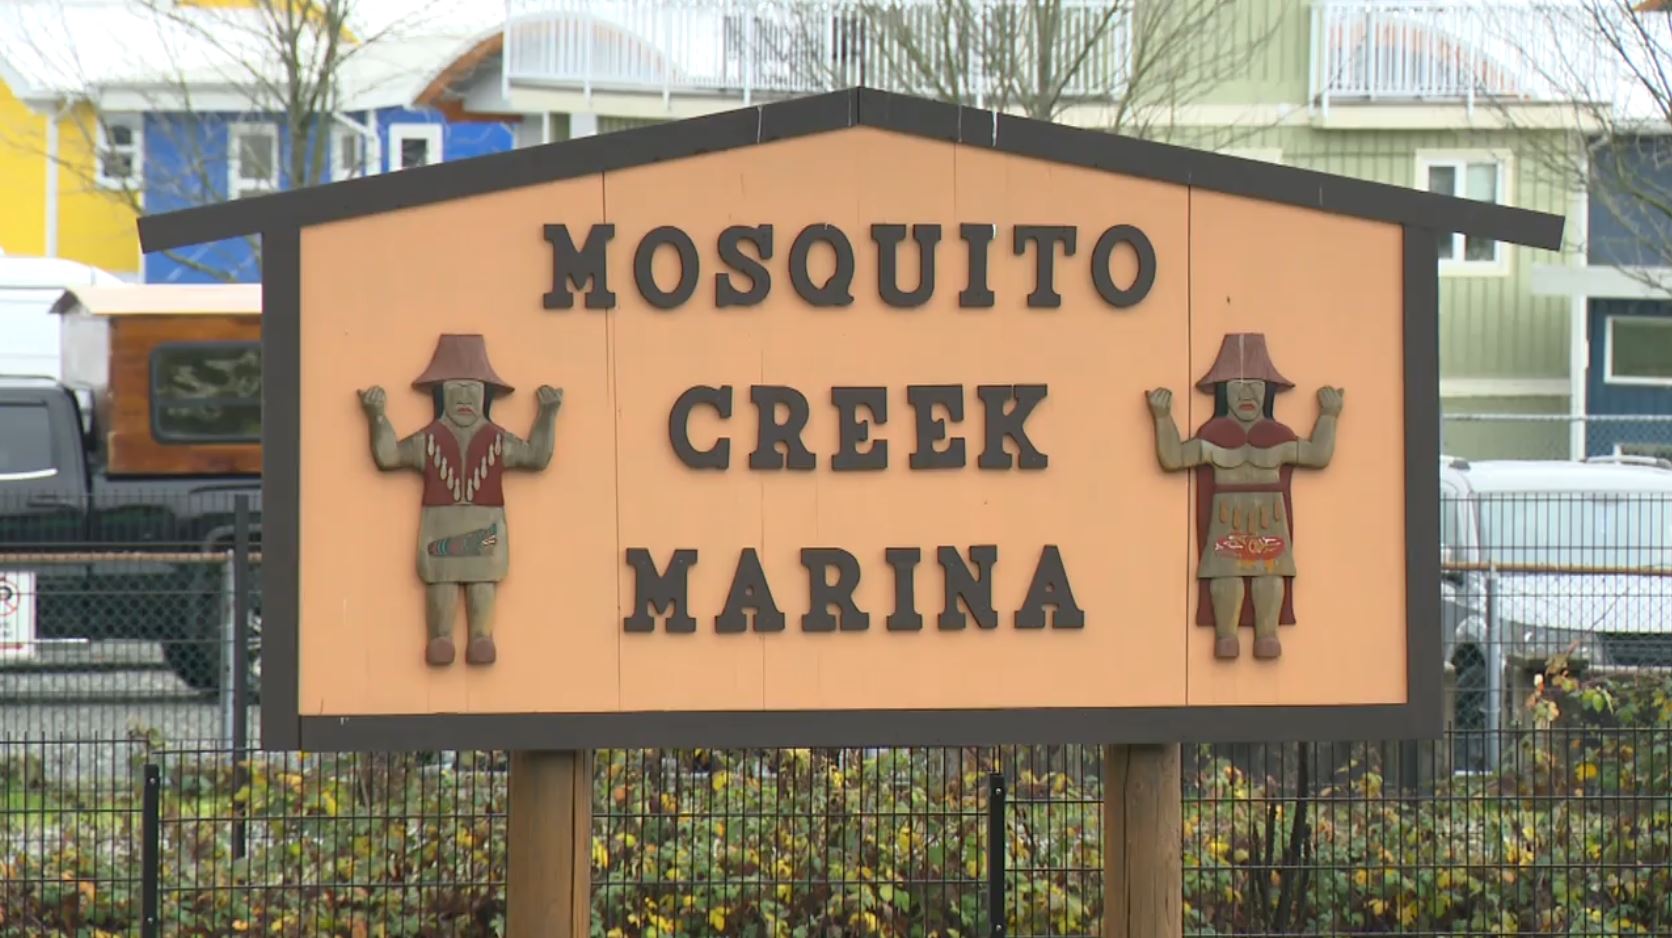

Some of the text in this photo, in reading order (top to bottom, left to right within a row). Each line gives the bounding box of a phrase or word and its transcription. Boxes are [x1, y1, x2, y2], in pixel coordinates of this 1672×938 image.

[543, 223, 1157, 310] MOSQUITO
[669, 384, 1048, 471] CREEK
[624, 545, 1085, 634] MARINA
